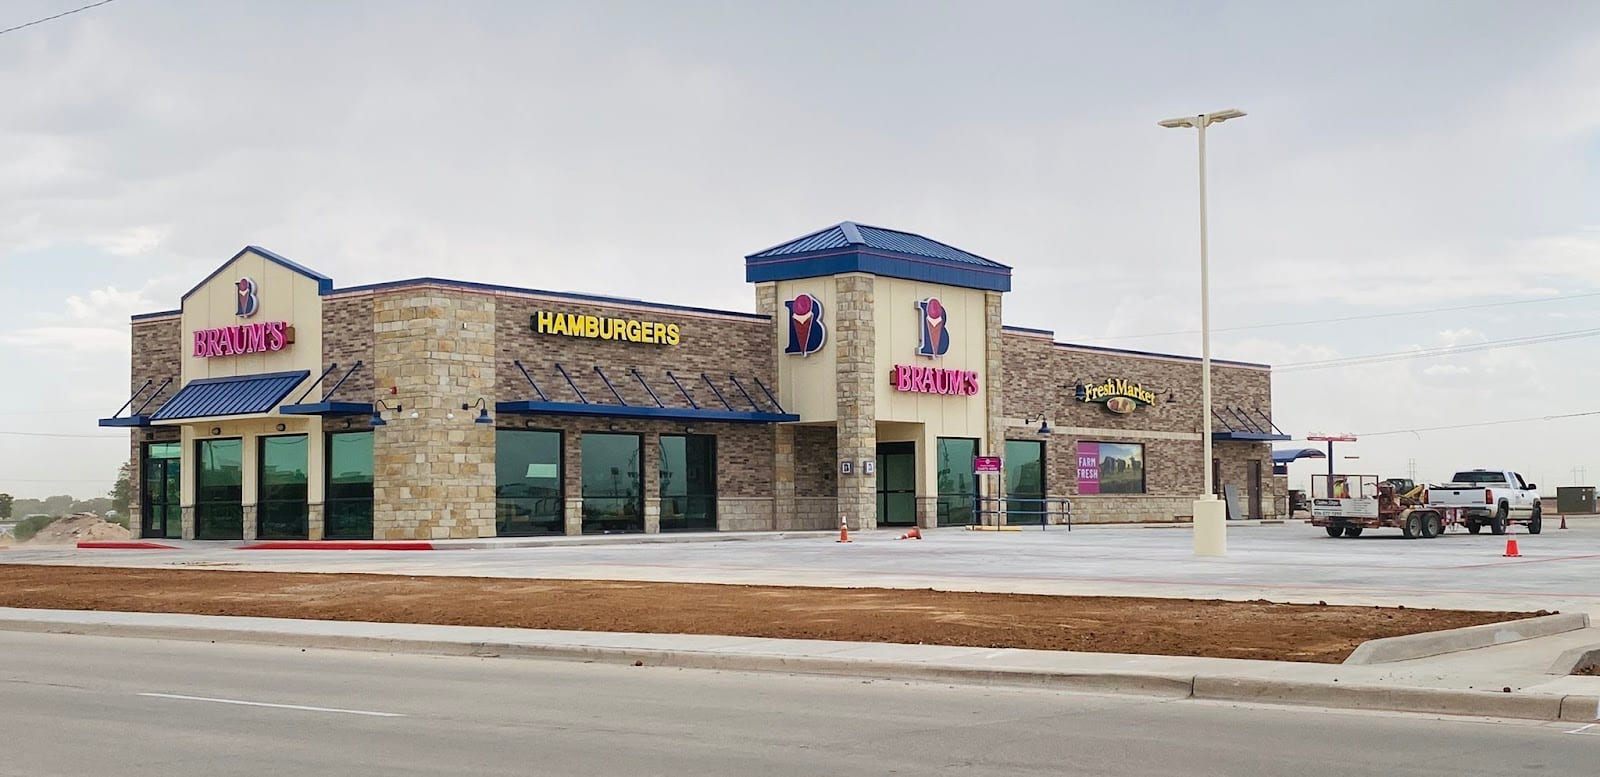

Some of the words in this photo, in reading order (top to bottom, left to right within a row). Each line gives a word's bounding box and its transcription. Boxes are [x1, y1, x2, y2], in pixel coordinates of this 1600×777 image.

[193, 321, 286, 357] BRAUM'S
[537, 310, 680, 346] HAMBURGERS
[896, 364, 980, 396] BRAUM'S
[1077, 468, 1098, 479] FRESH
[1078, 456, 1096, 468] FARM
